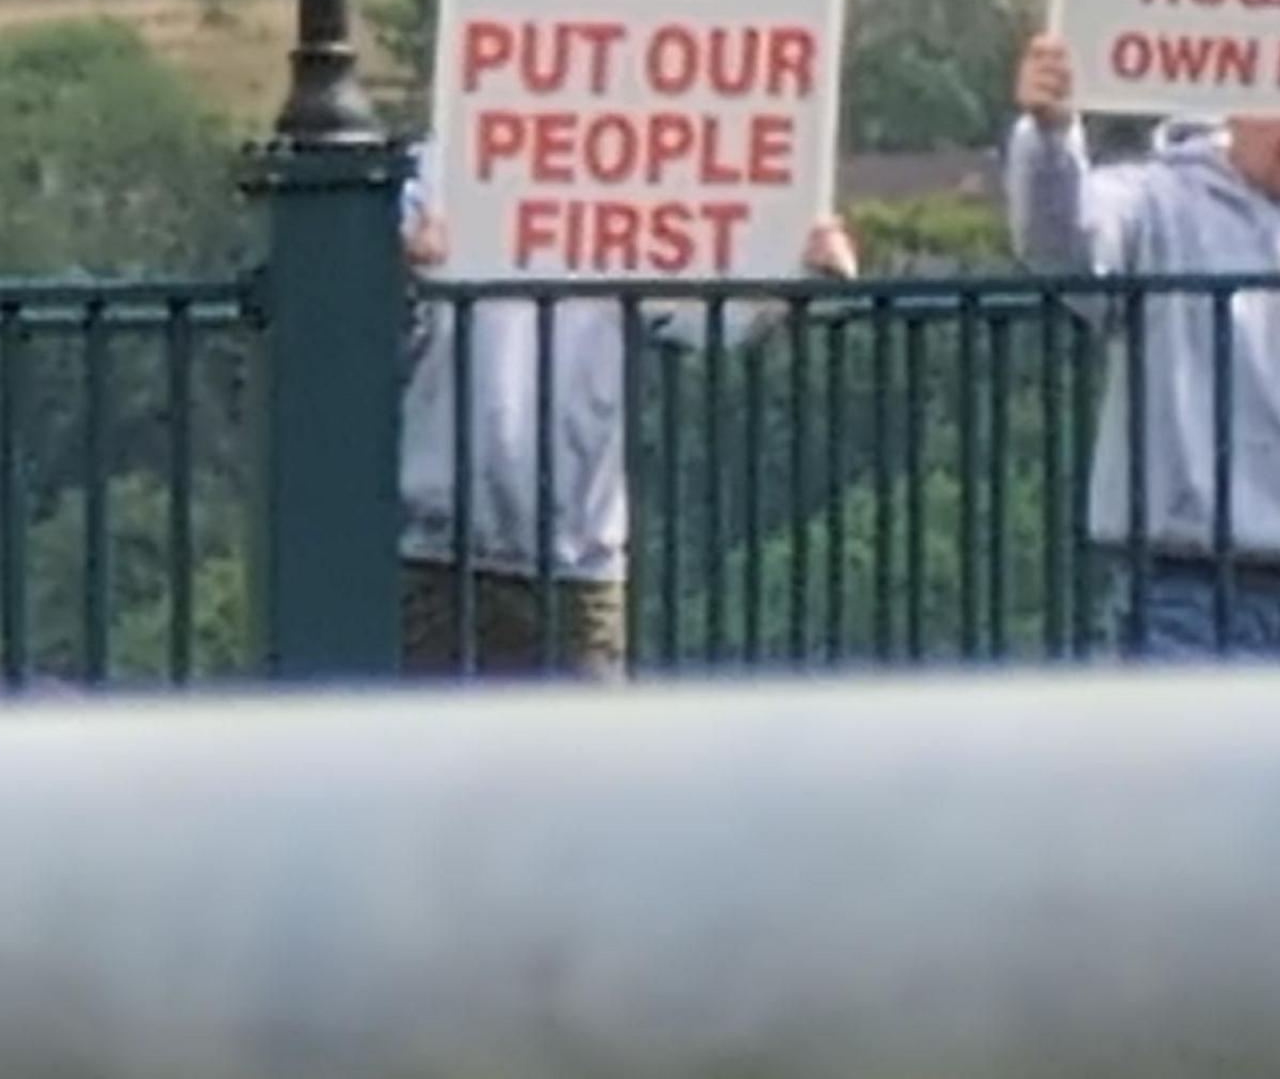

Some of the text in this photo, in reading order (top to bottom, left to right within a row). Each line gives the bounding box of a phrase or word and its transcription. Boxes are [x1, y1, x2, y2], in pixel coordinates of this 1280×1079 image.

[462, 21, 817, 97] PUT OUR
[1110, 31, 1258, 86] OWN
[476, 111, 794, 186] PEOPLE
[513, 200, 749, 273] FIRST
